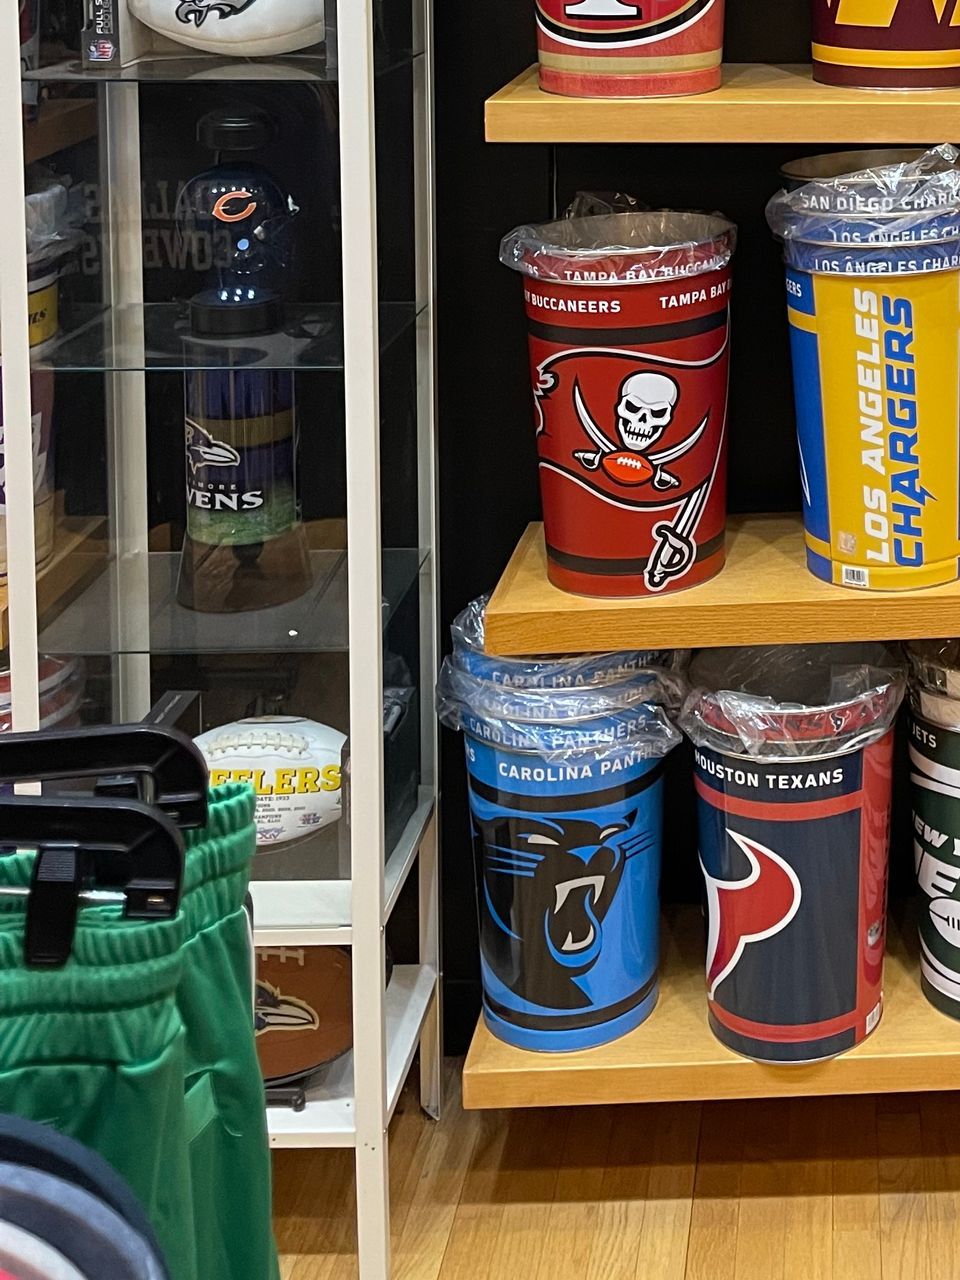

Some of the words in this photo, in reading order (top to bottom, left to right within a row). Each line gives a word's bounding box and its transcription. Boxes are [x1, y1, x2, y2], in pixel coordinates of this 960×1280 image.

[95, 8, 104, 35] FULL
[801, 195, 830, 210] SAN
[532, 294, 621, 313] BUCCANEERS
[660, 292, 707, 308] TAMPA
[710, 281, 726, 299] BAY
[853, 287, 887, 476] ANGELES
[881, 295, 930, 568] CHARGERS
[863, 485, 890, 563] LOS
[499, 762, 593, 782] CAROLINA
[695, 749, 759, 788] HOUSTON
[766, 768, 844, 789] TEXANS
